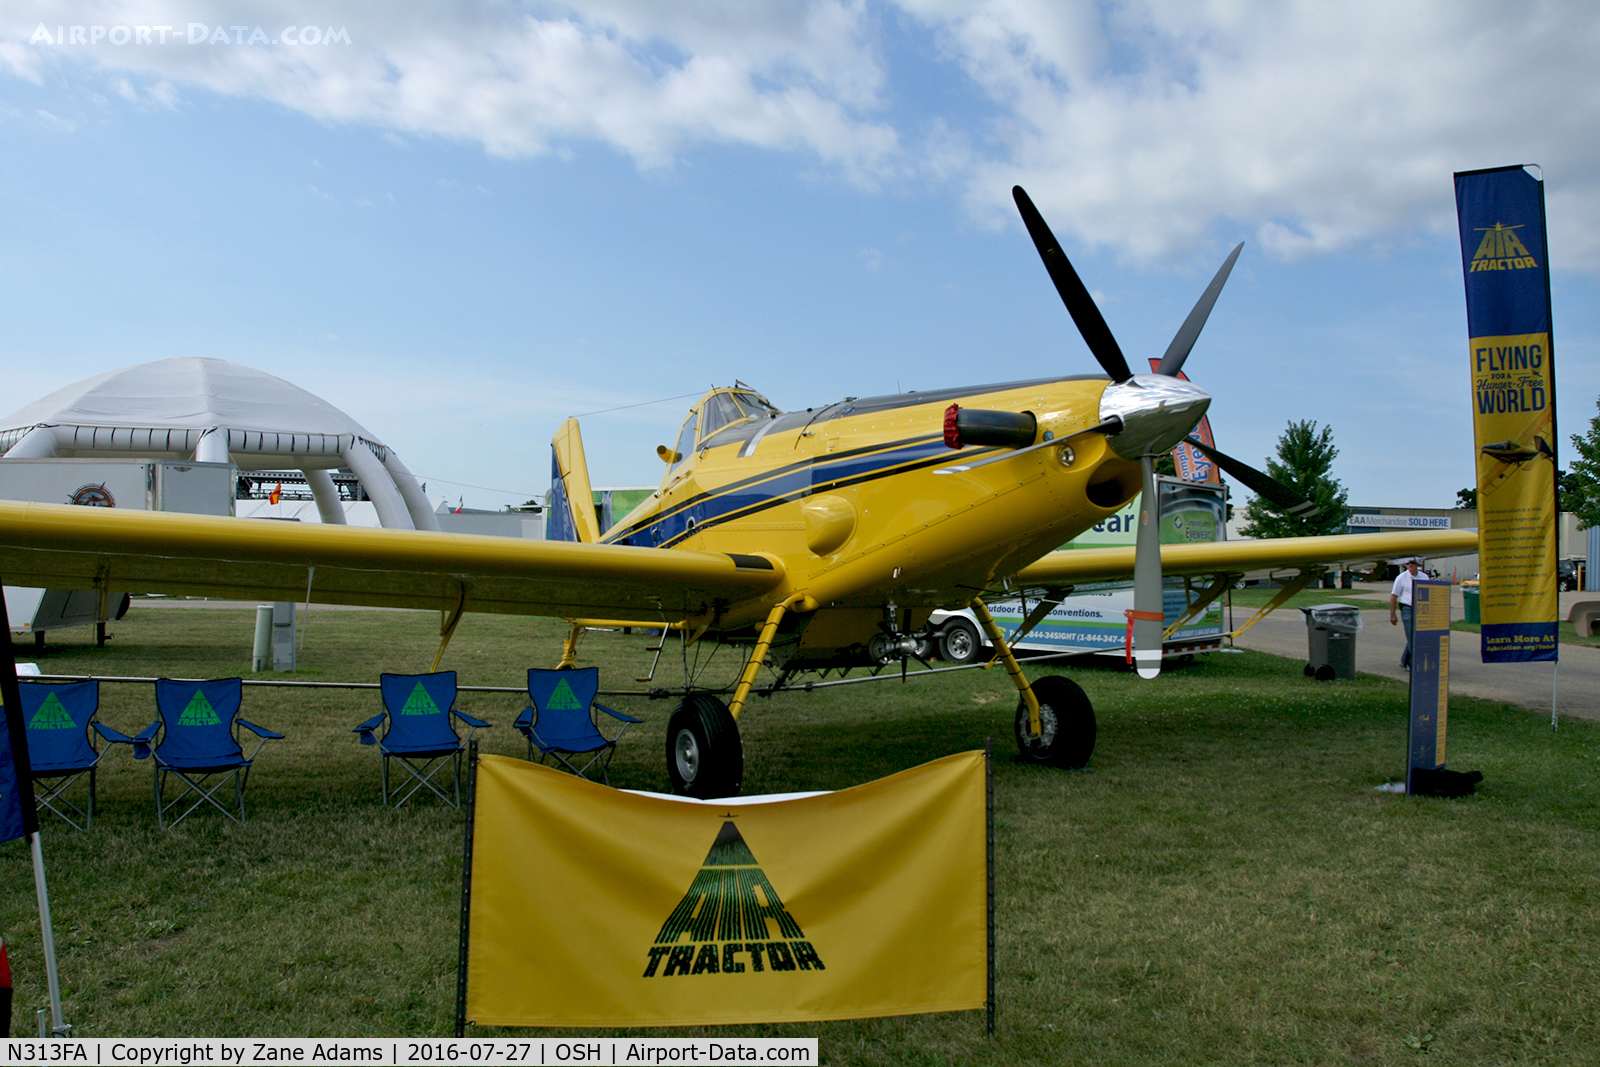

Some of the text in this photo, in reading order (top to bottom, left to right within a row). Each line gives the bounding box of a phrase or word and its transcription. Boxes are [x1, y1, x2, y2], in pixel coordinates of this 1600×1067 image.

[1473, 229, 1530, 259] AIR
[1469, 256, 1538, 273] TRACTOR
[1476, 344, 1542, 372] FLYING
[1476, 375, 1544, 394] Hunger-Free
[1477, 387, 1545, 414] WORLD
[1091, 513, 1135, 533] ear
[1349, 516, 1449, 527] EAA Merchandise SOLD HERE
[1186, 527, 1211, 541] Eyewear
[1024, 630, 1077, 641] -844-34SIGHT
[1486, 634, 1555, 644] Learn More At
[403, 690, 437, 708] AIR
[548, 687, 579, 704] AIR
[31, 702, 71, 721] AIR
[180, 700, 218, 719] AIR
[401, 707, 441, 716] TRACTOR
[545, 702, 583, 710] TRACTOR
[27, 720, 78, 730] TRACTOR
[177, 717, 222, 726] TRACTOR
[654, 868, 806, 944] AIR
[642, 941, 826, 978] TRACTOR
